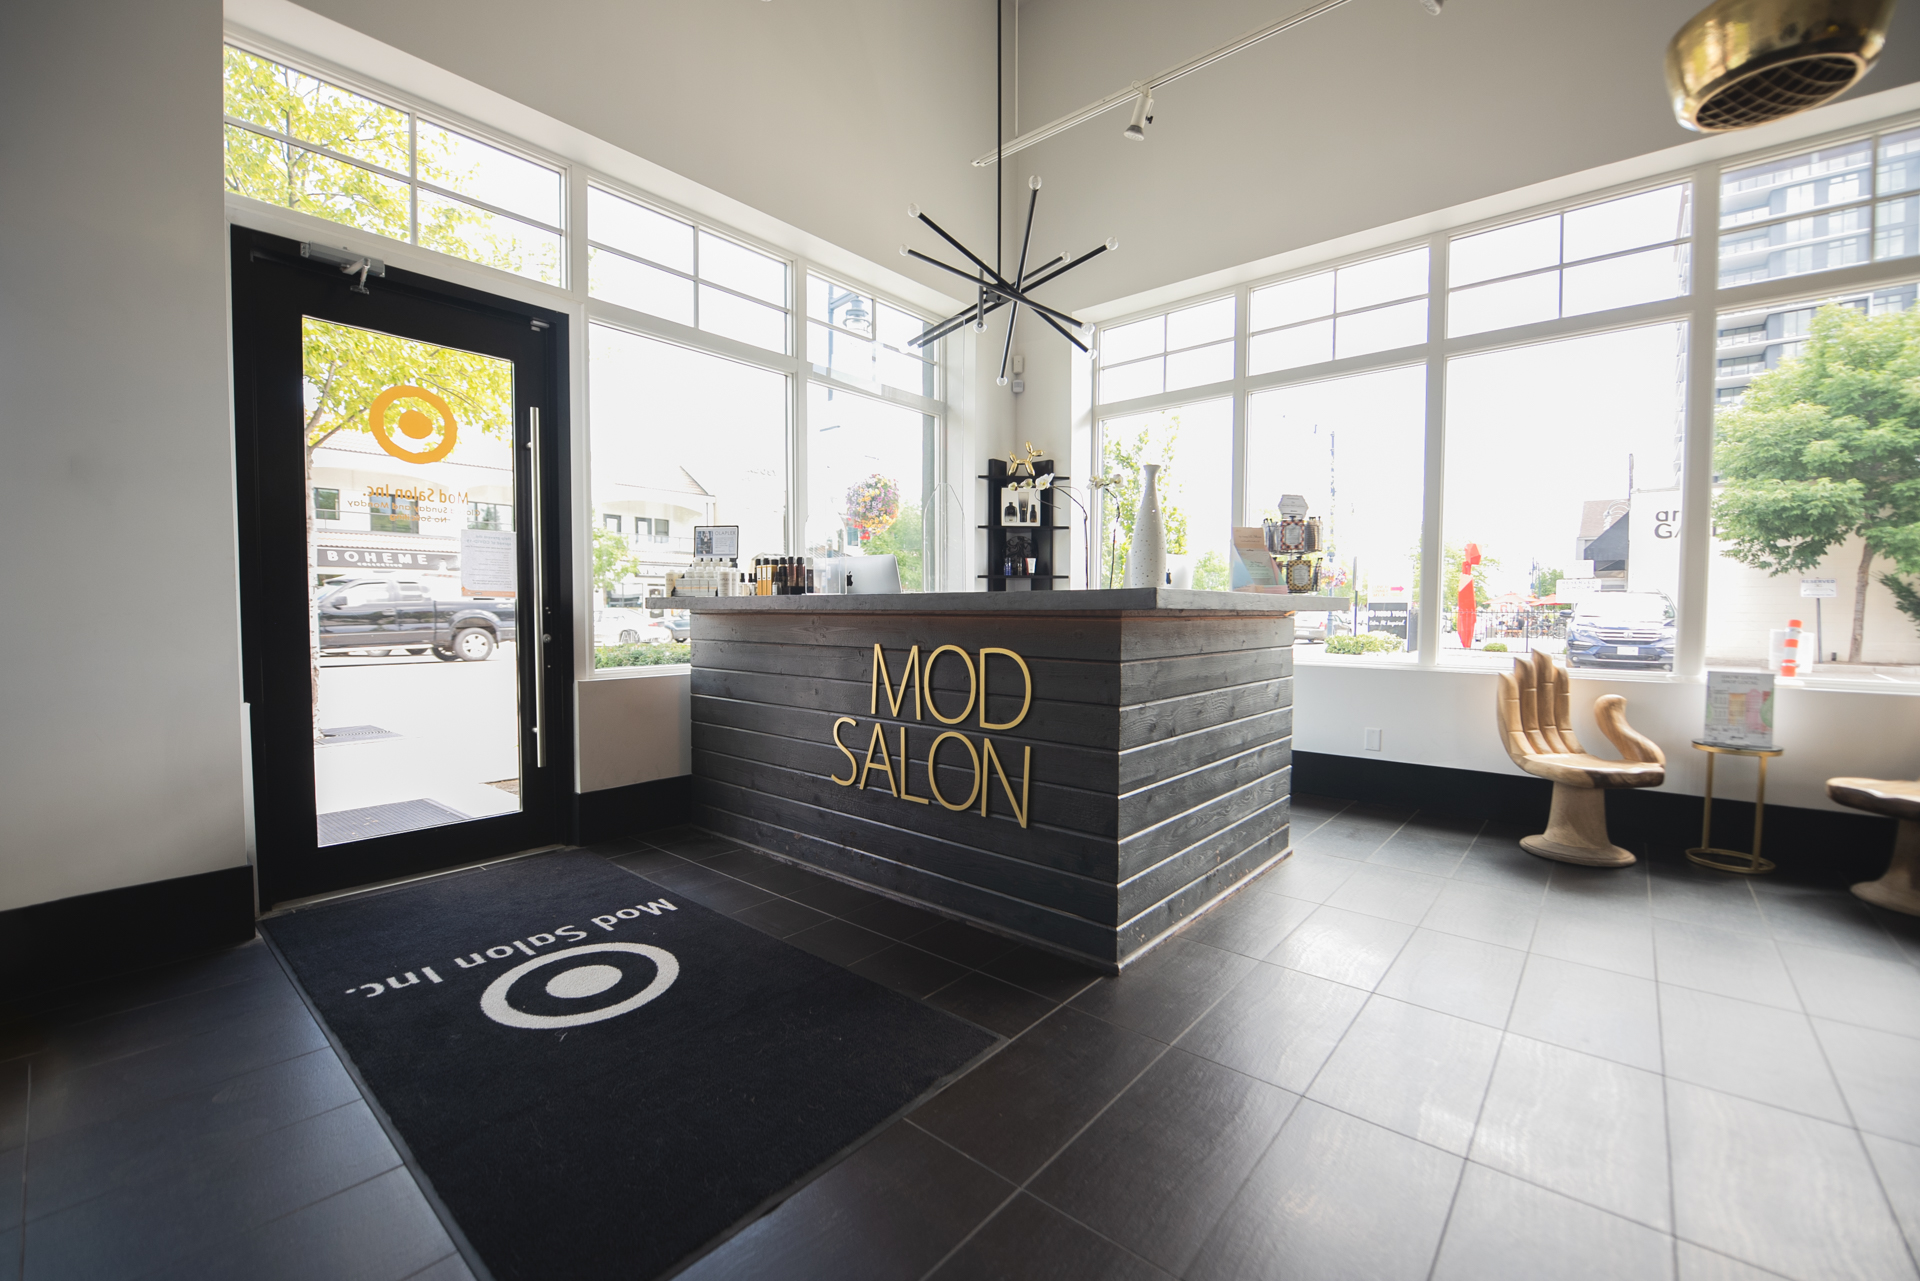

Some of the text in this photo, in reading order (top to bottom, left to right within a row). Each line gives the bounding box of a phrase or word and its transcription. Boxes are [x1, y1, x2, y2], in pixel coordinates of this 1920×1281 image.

[326, 550, 429, 565] BOHEME
[871, 643, 1032, 730] MOD
[830, 716, 1031, 829] SALON
[345, 898, 679, 998] Mod Salon Inc.
